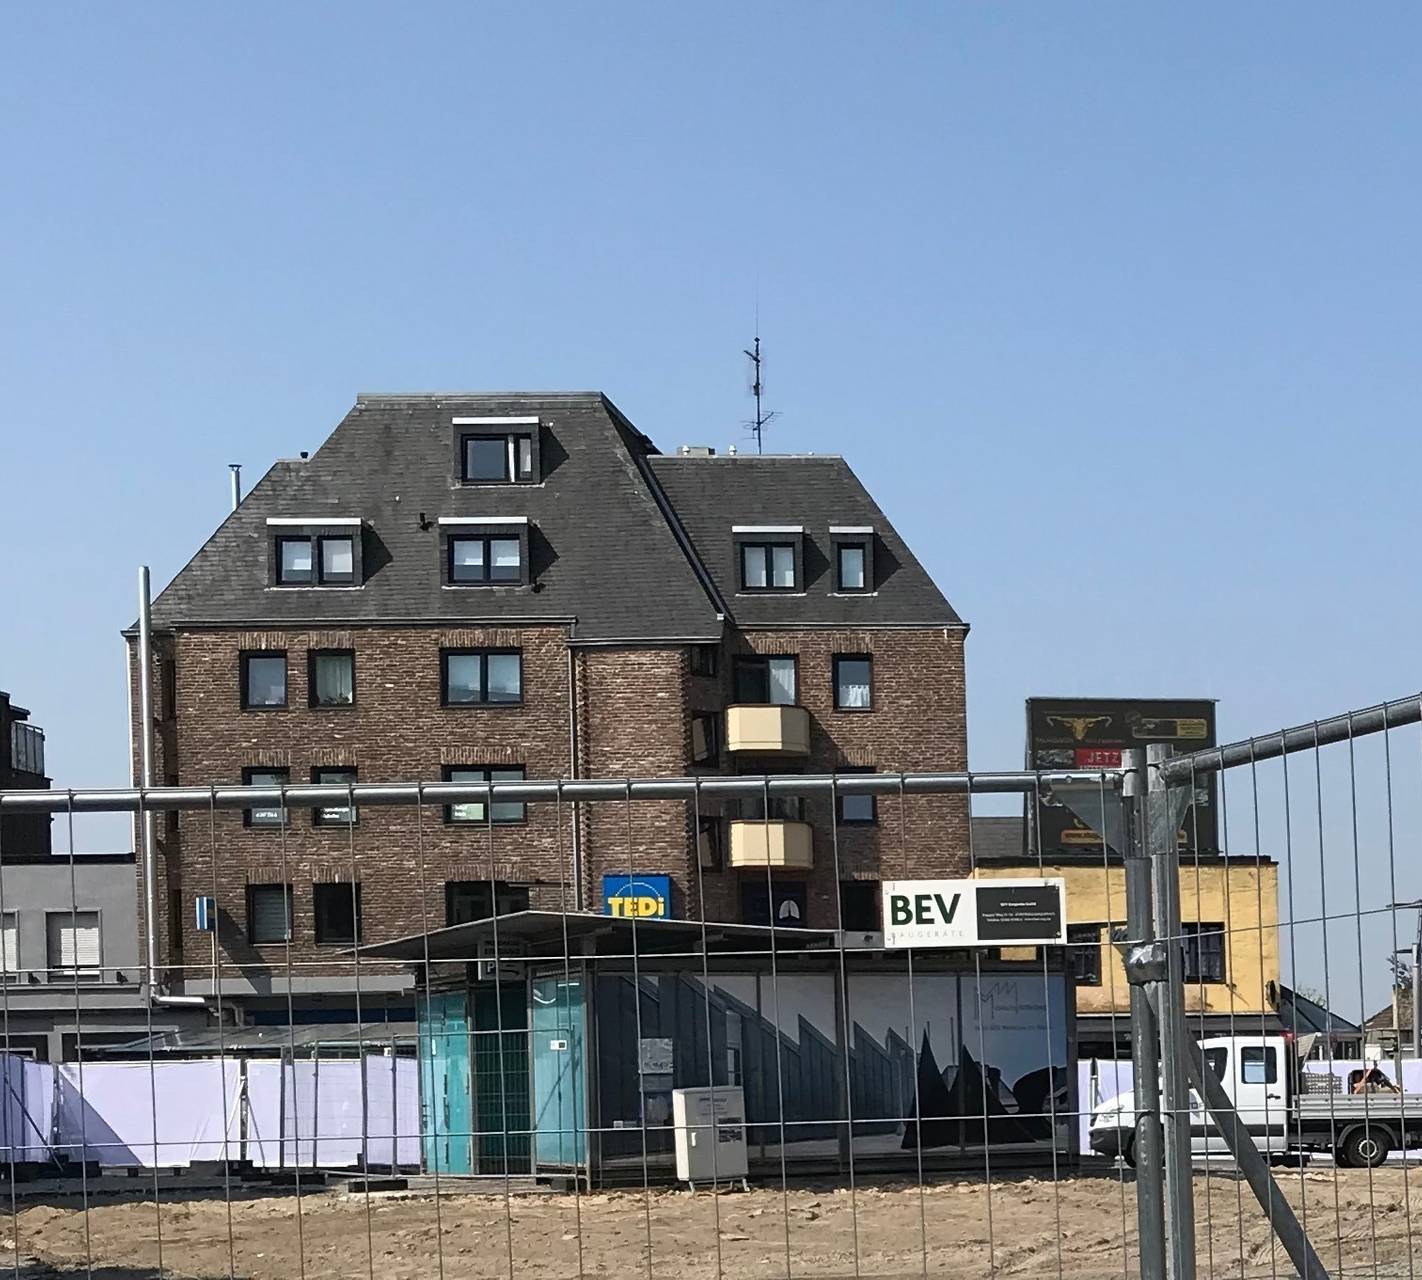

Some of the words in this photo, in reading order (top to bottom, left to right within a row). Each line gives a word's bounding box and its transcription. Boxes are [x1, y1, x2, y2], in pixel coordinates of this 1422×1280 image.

[1087, 751, 1120, 764] JETZ
[607, 896, 665, 918] TEDi
[890, 893, 962, 926] BEV
